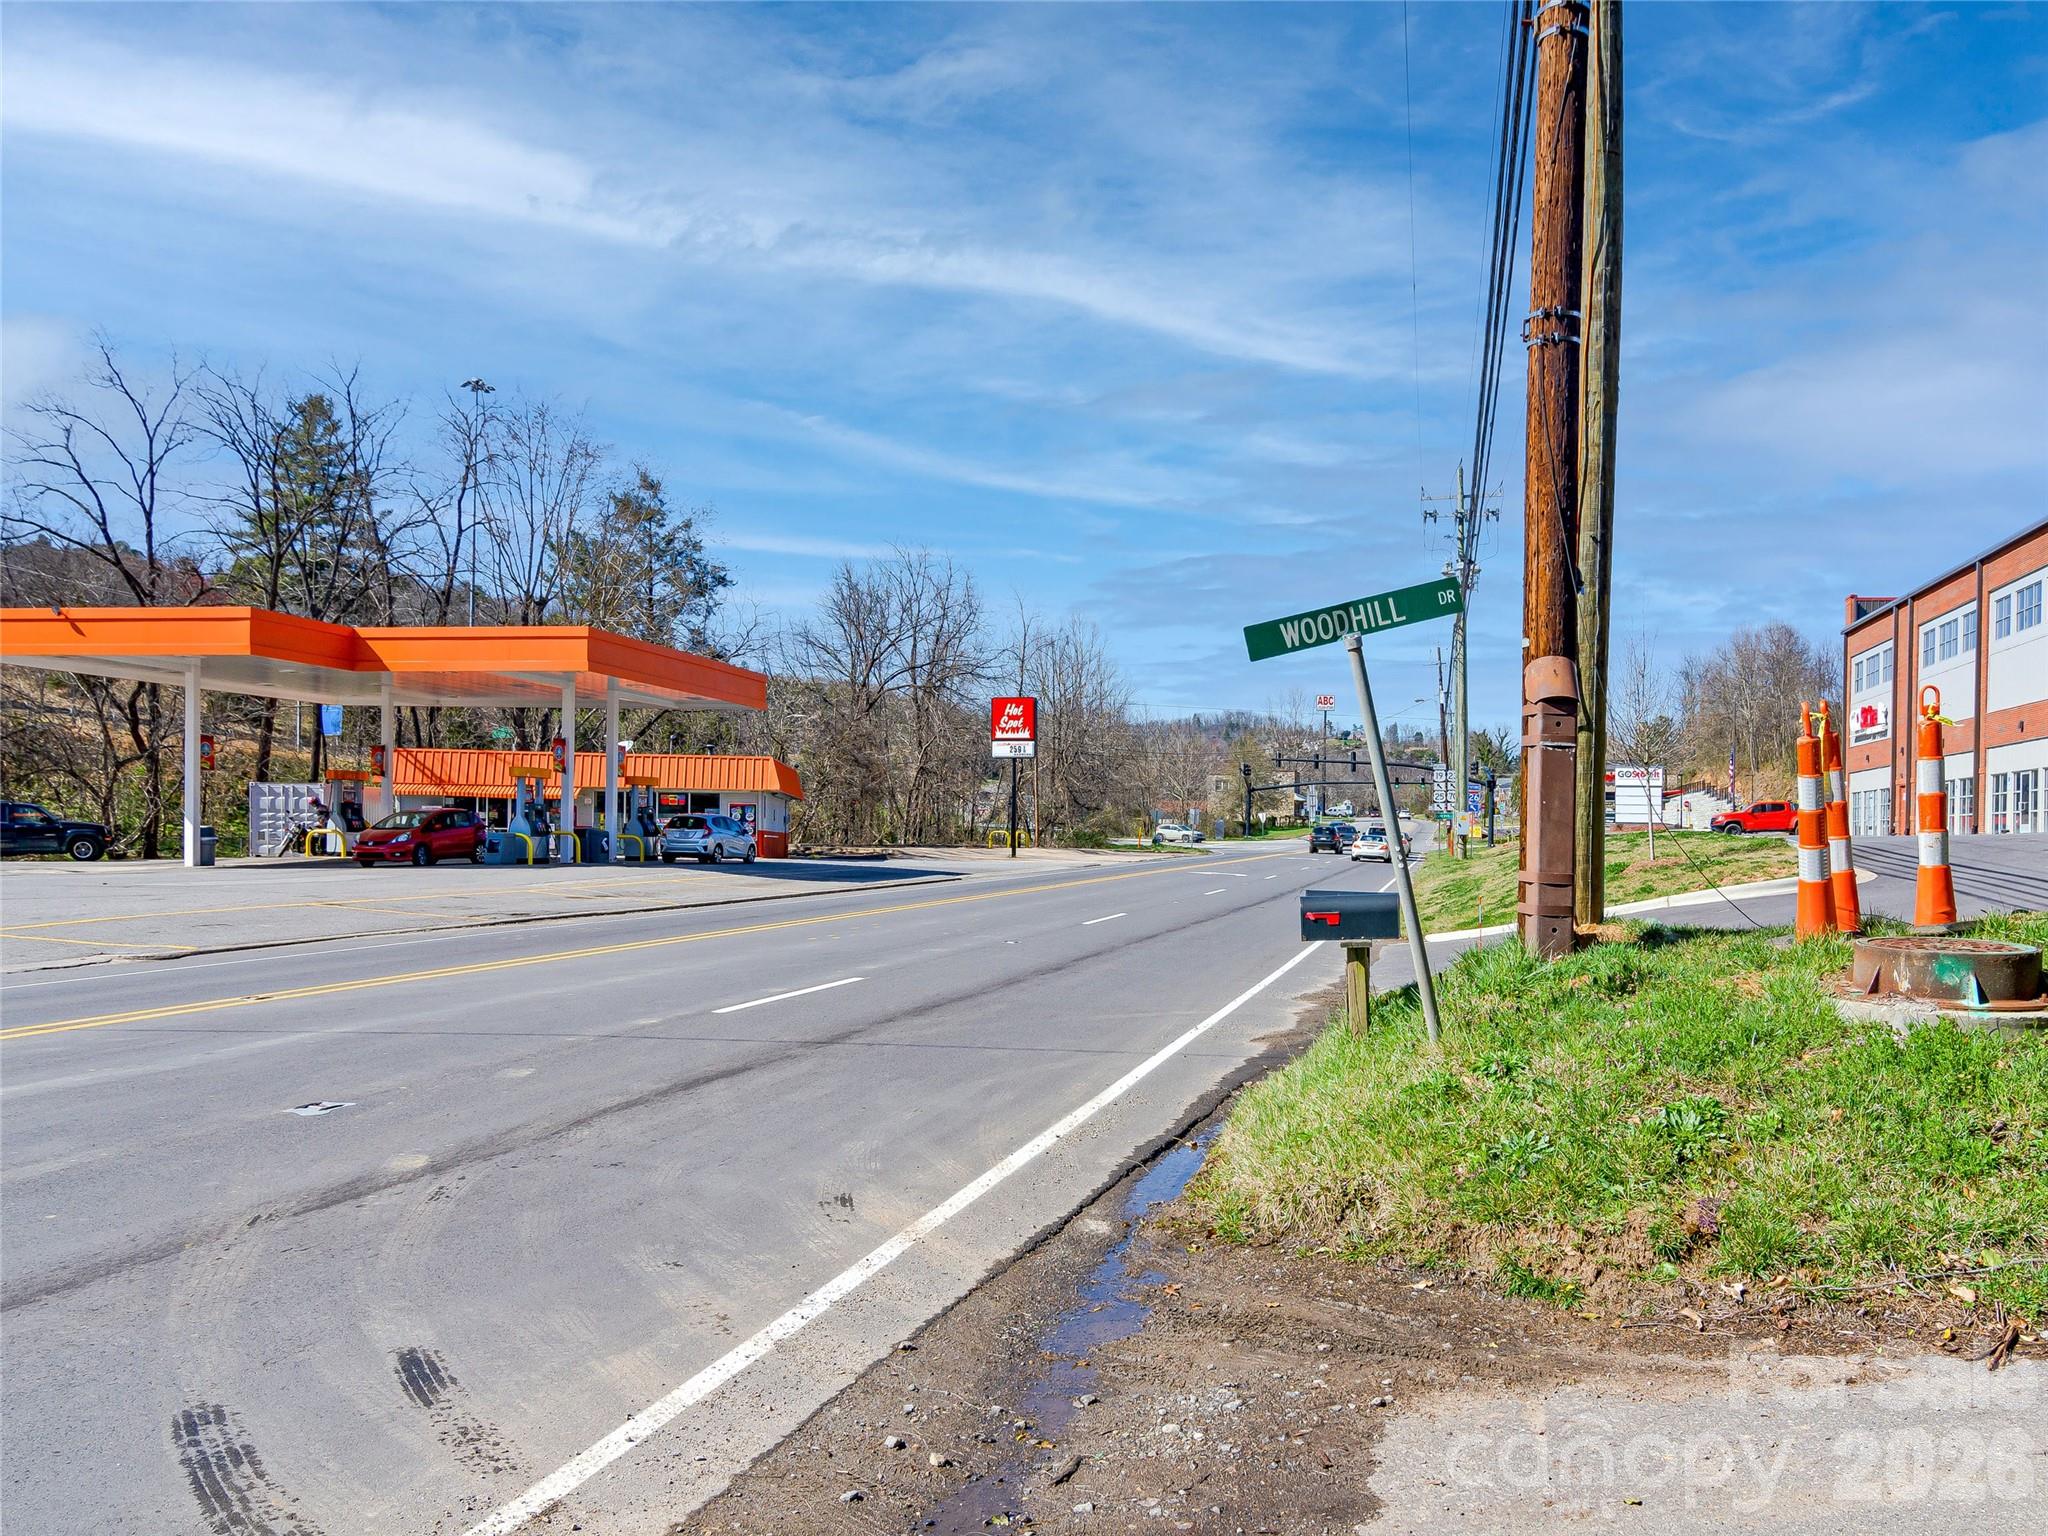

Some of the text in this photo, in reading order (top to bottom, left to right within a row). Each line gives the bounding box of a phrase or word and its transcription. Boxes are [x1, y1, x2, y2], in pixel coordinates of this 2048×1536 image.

[1279, 589, 1456, 649] WOODHILL DR
[1317, 696, 1334, 706] ABC
[1004, 703, 1024, 715] Hot
[999, 715, 1024, 730] Spot
[1468, 793, 1480, 801] 26
